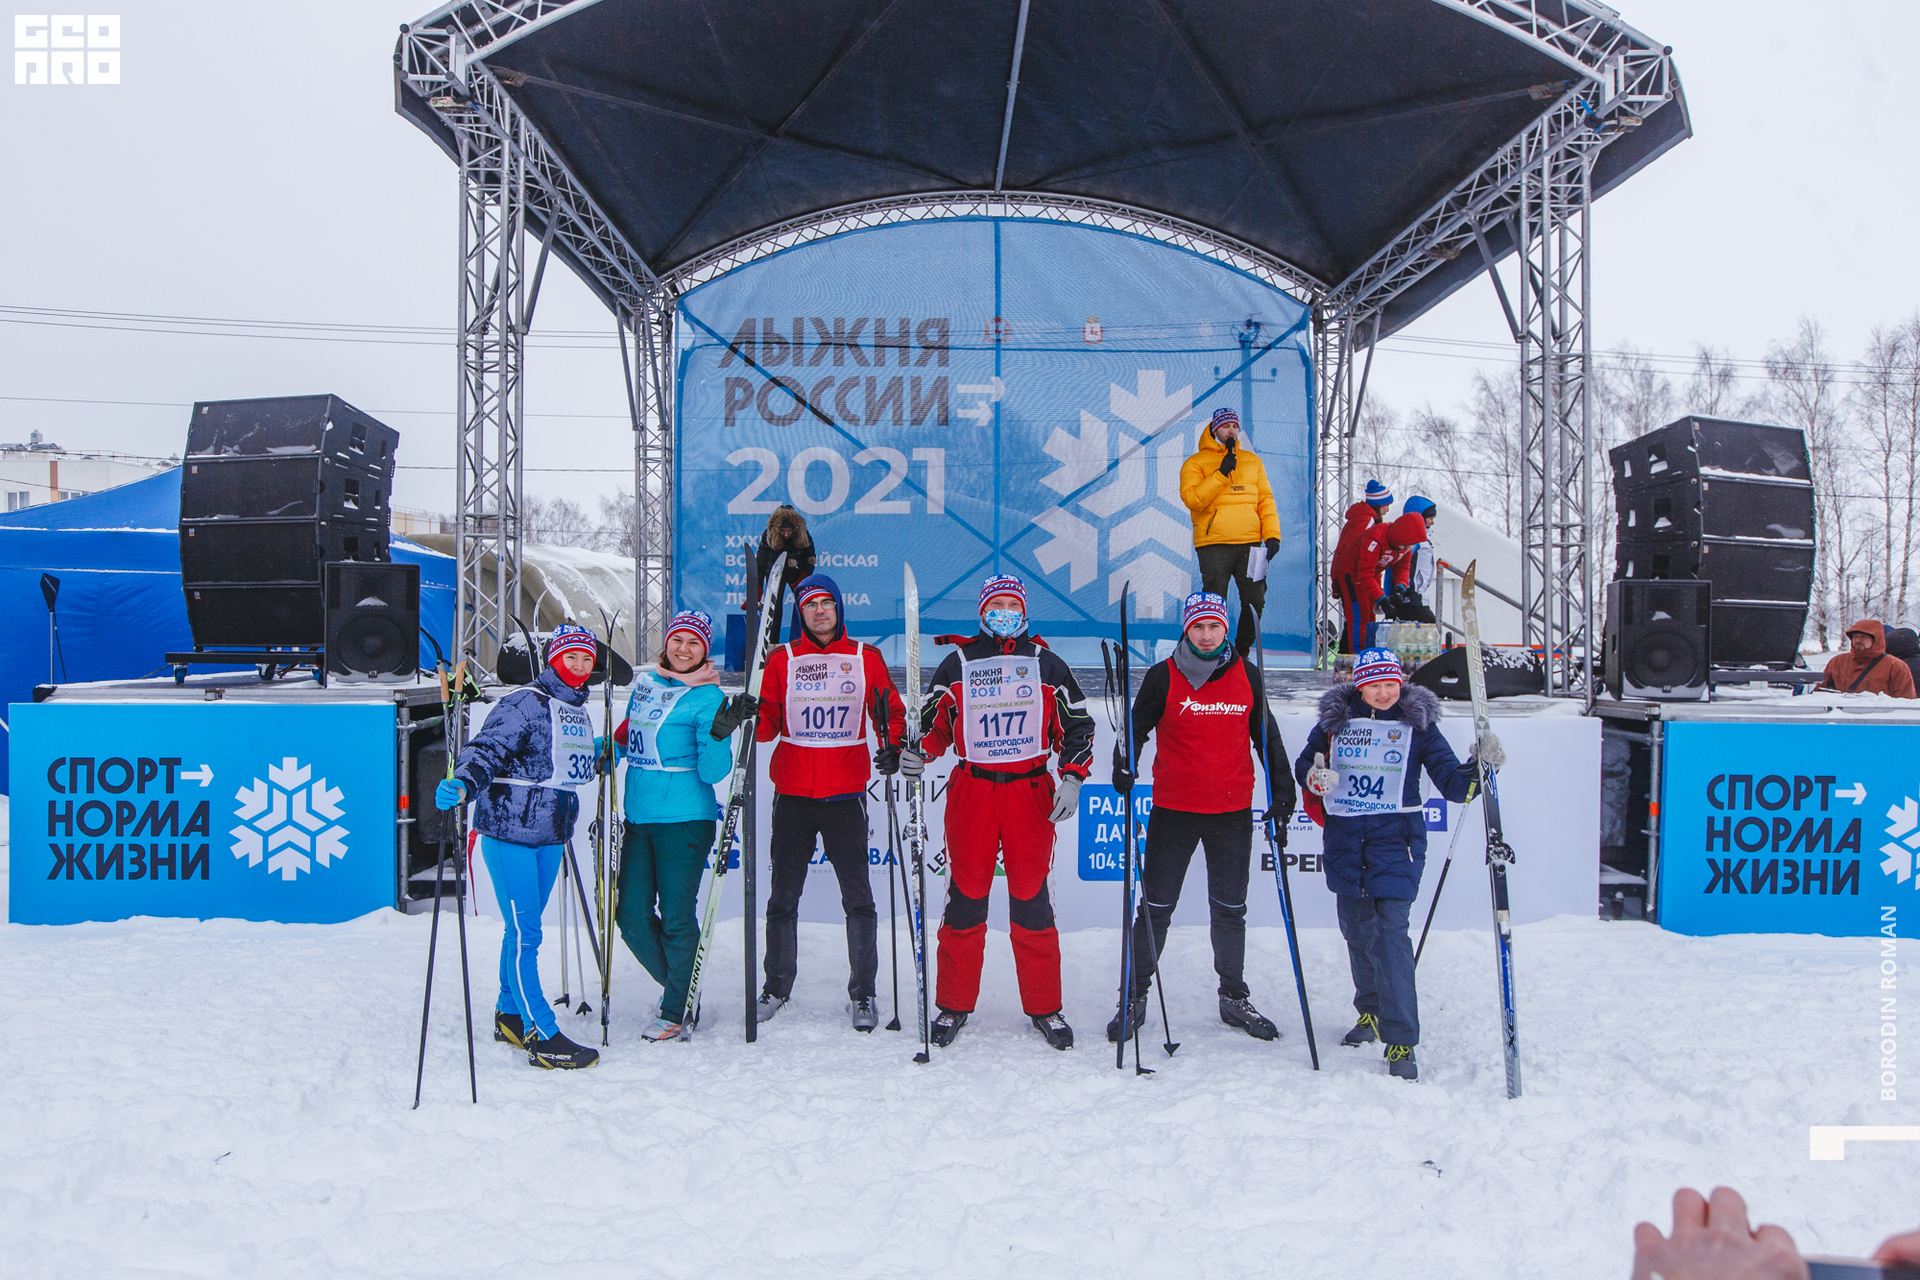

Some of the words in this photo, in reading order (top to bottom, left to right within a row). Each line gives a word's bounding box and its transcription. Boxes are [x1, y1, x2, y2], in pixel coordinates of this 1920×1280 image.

[717, 316, 950, 368] ЛЫЖНЯ
[724, 375, 949, 427] РОССИИ
[724, 446, 946, 516] 2021
[795, 663, 828, 674] ЛЫЖНЯ
[795, 671, 828, 682] РОССИИ
[910, 629, 920, 711] FISCHER
[969, 667, 1003, 679] ЛЫЖНЯ
[1470, 634, 1489, 720] FISCHER
[795, 682, 827, 691] 2021
[970, 675, 1003, 687] РОССИИ
[970, 686, 1002, 698] 2021
[801, 706, 850, 729] 1017
[1190, 702, 1248, 714] ФизКульт
[561, 724, 588, 738] 2021
[795, 730, 852, 739] НИЖЕГОРОДСКАЯ
[979, 710, 1028, 738] 1177
[627, 728, 644, 755] 90
[973, 736, 1034, 749] НИЖЕГОРОДСКАЯ
[1337, 736, 1372, 746] РОССИИ
[988, 747, 1022, 757] ОБЛАСТЬ
[1337, 746, 1368, 758] 2021
[47, 757, 182, 794] СПОРТ
[1347, 774, 1385, 800] 394
[1706, 773, 1836, 811] СПОРТ
[1334, 798, 1397, 810] НИЖЕГОРОДСКАЯ
[48, 800, 210, 837] НОРМА
[1094, 824, 1147, 843] ДАА
[1705, 816, 1862, 854] НОРМА
[46, 843, 210, 880] ЖИЗНИ
[1260, 853, 1323, 872] ВРЕ
[1702, 858, 1860, 895] ЖИЗНИ
[685, 943, 706, 1012] ETERNITY
